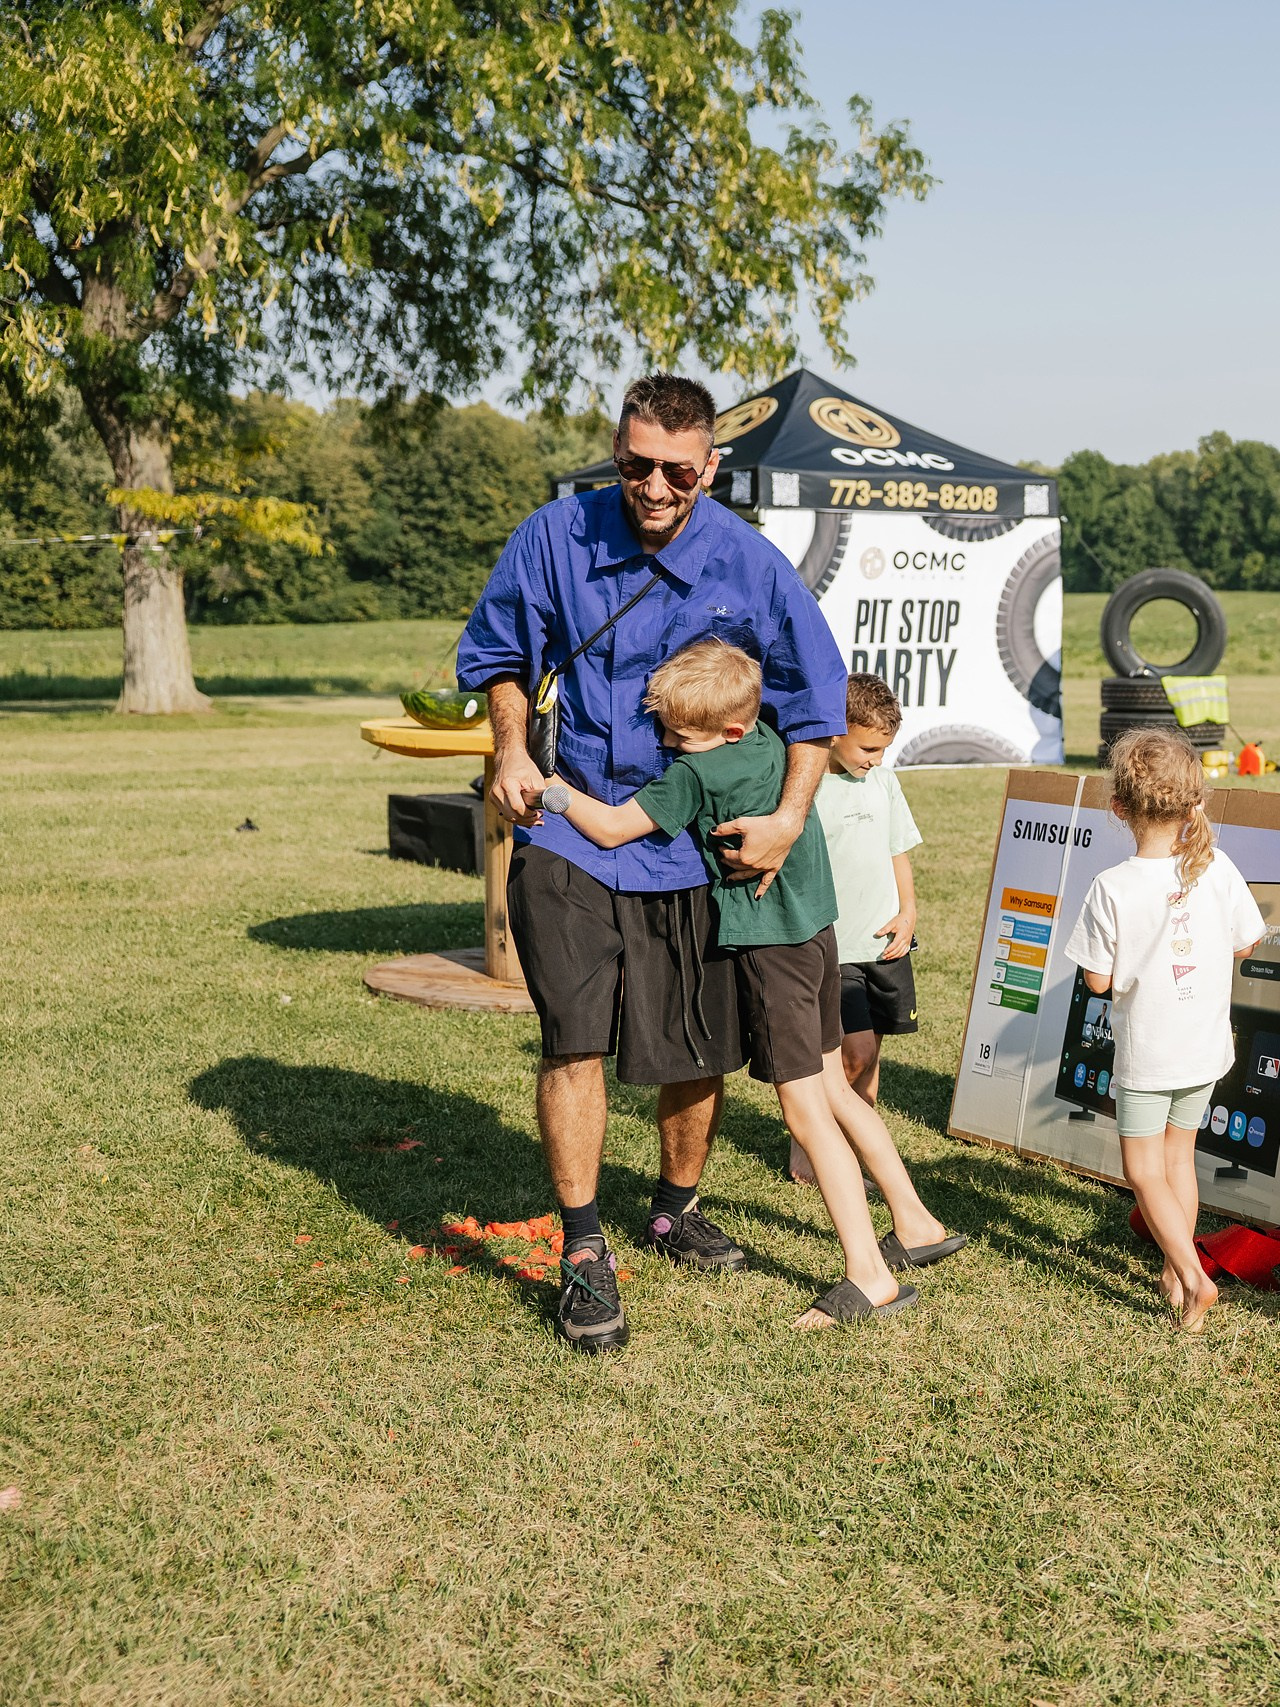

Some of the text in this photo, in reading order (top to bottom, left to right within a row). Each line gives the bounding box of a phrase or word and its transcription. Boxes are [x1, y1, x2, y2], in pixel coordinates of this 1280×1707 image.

[830, 447, 955, 471] OCMC
[829, 479, 998, 513] 773-382-8208
[893, 551, 966, 571] OCMC
[854, 599, 960, 643] PIT STOP
[1012, 819, 1092, 848] SAMSUNG
[1009, 895, 1053, 913] Why Samsung
[1263, 935, 1273, 945] TV
[979, 1043, 991, 1060] 18
